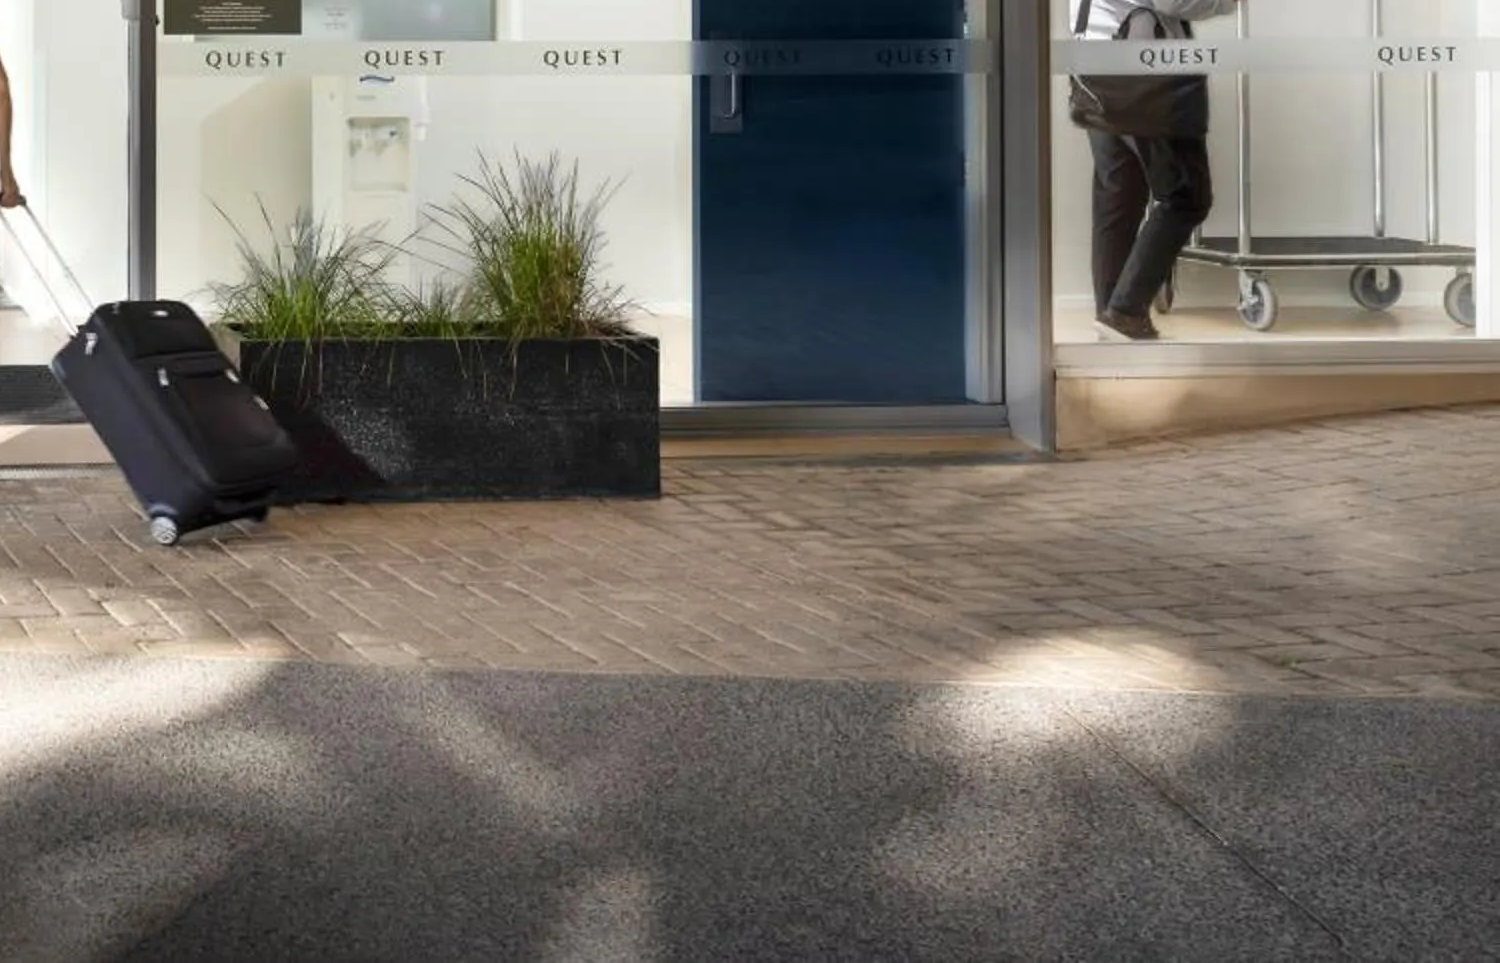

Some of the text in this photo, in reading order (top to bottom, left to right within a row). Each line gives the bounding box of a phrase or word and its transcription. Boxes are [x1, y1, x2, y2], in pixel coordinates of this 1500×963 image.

[205, 50, 286, 69] QUEST
[364, 49, 445, 67] QUEST
[543, 49, 623, 67] QUEST
[875, 48, 955, 67] QUEST
[1139, 46, 1457, 66] QUEST QUEST
